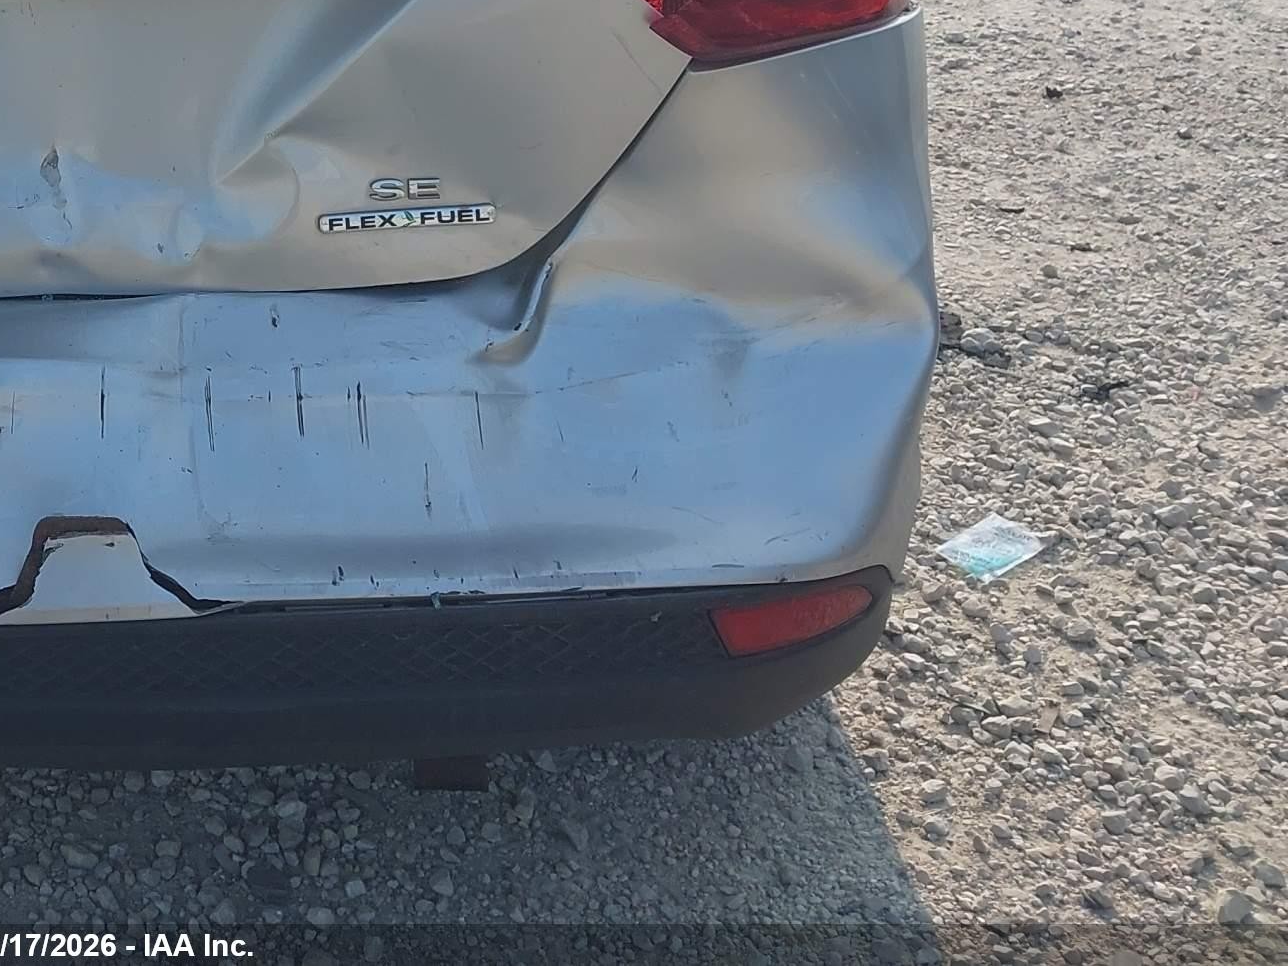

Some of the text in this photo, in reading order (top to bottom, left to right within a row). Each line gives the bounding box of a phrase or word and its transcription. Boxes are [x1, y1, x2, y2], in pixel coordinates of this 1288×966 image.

[369, 177, 441, 202] SE
[328, 208, 490, 231] FLEX FUEL
